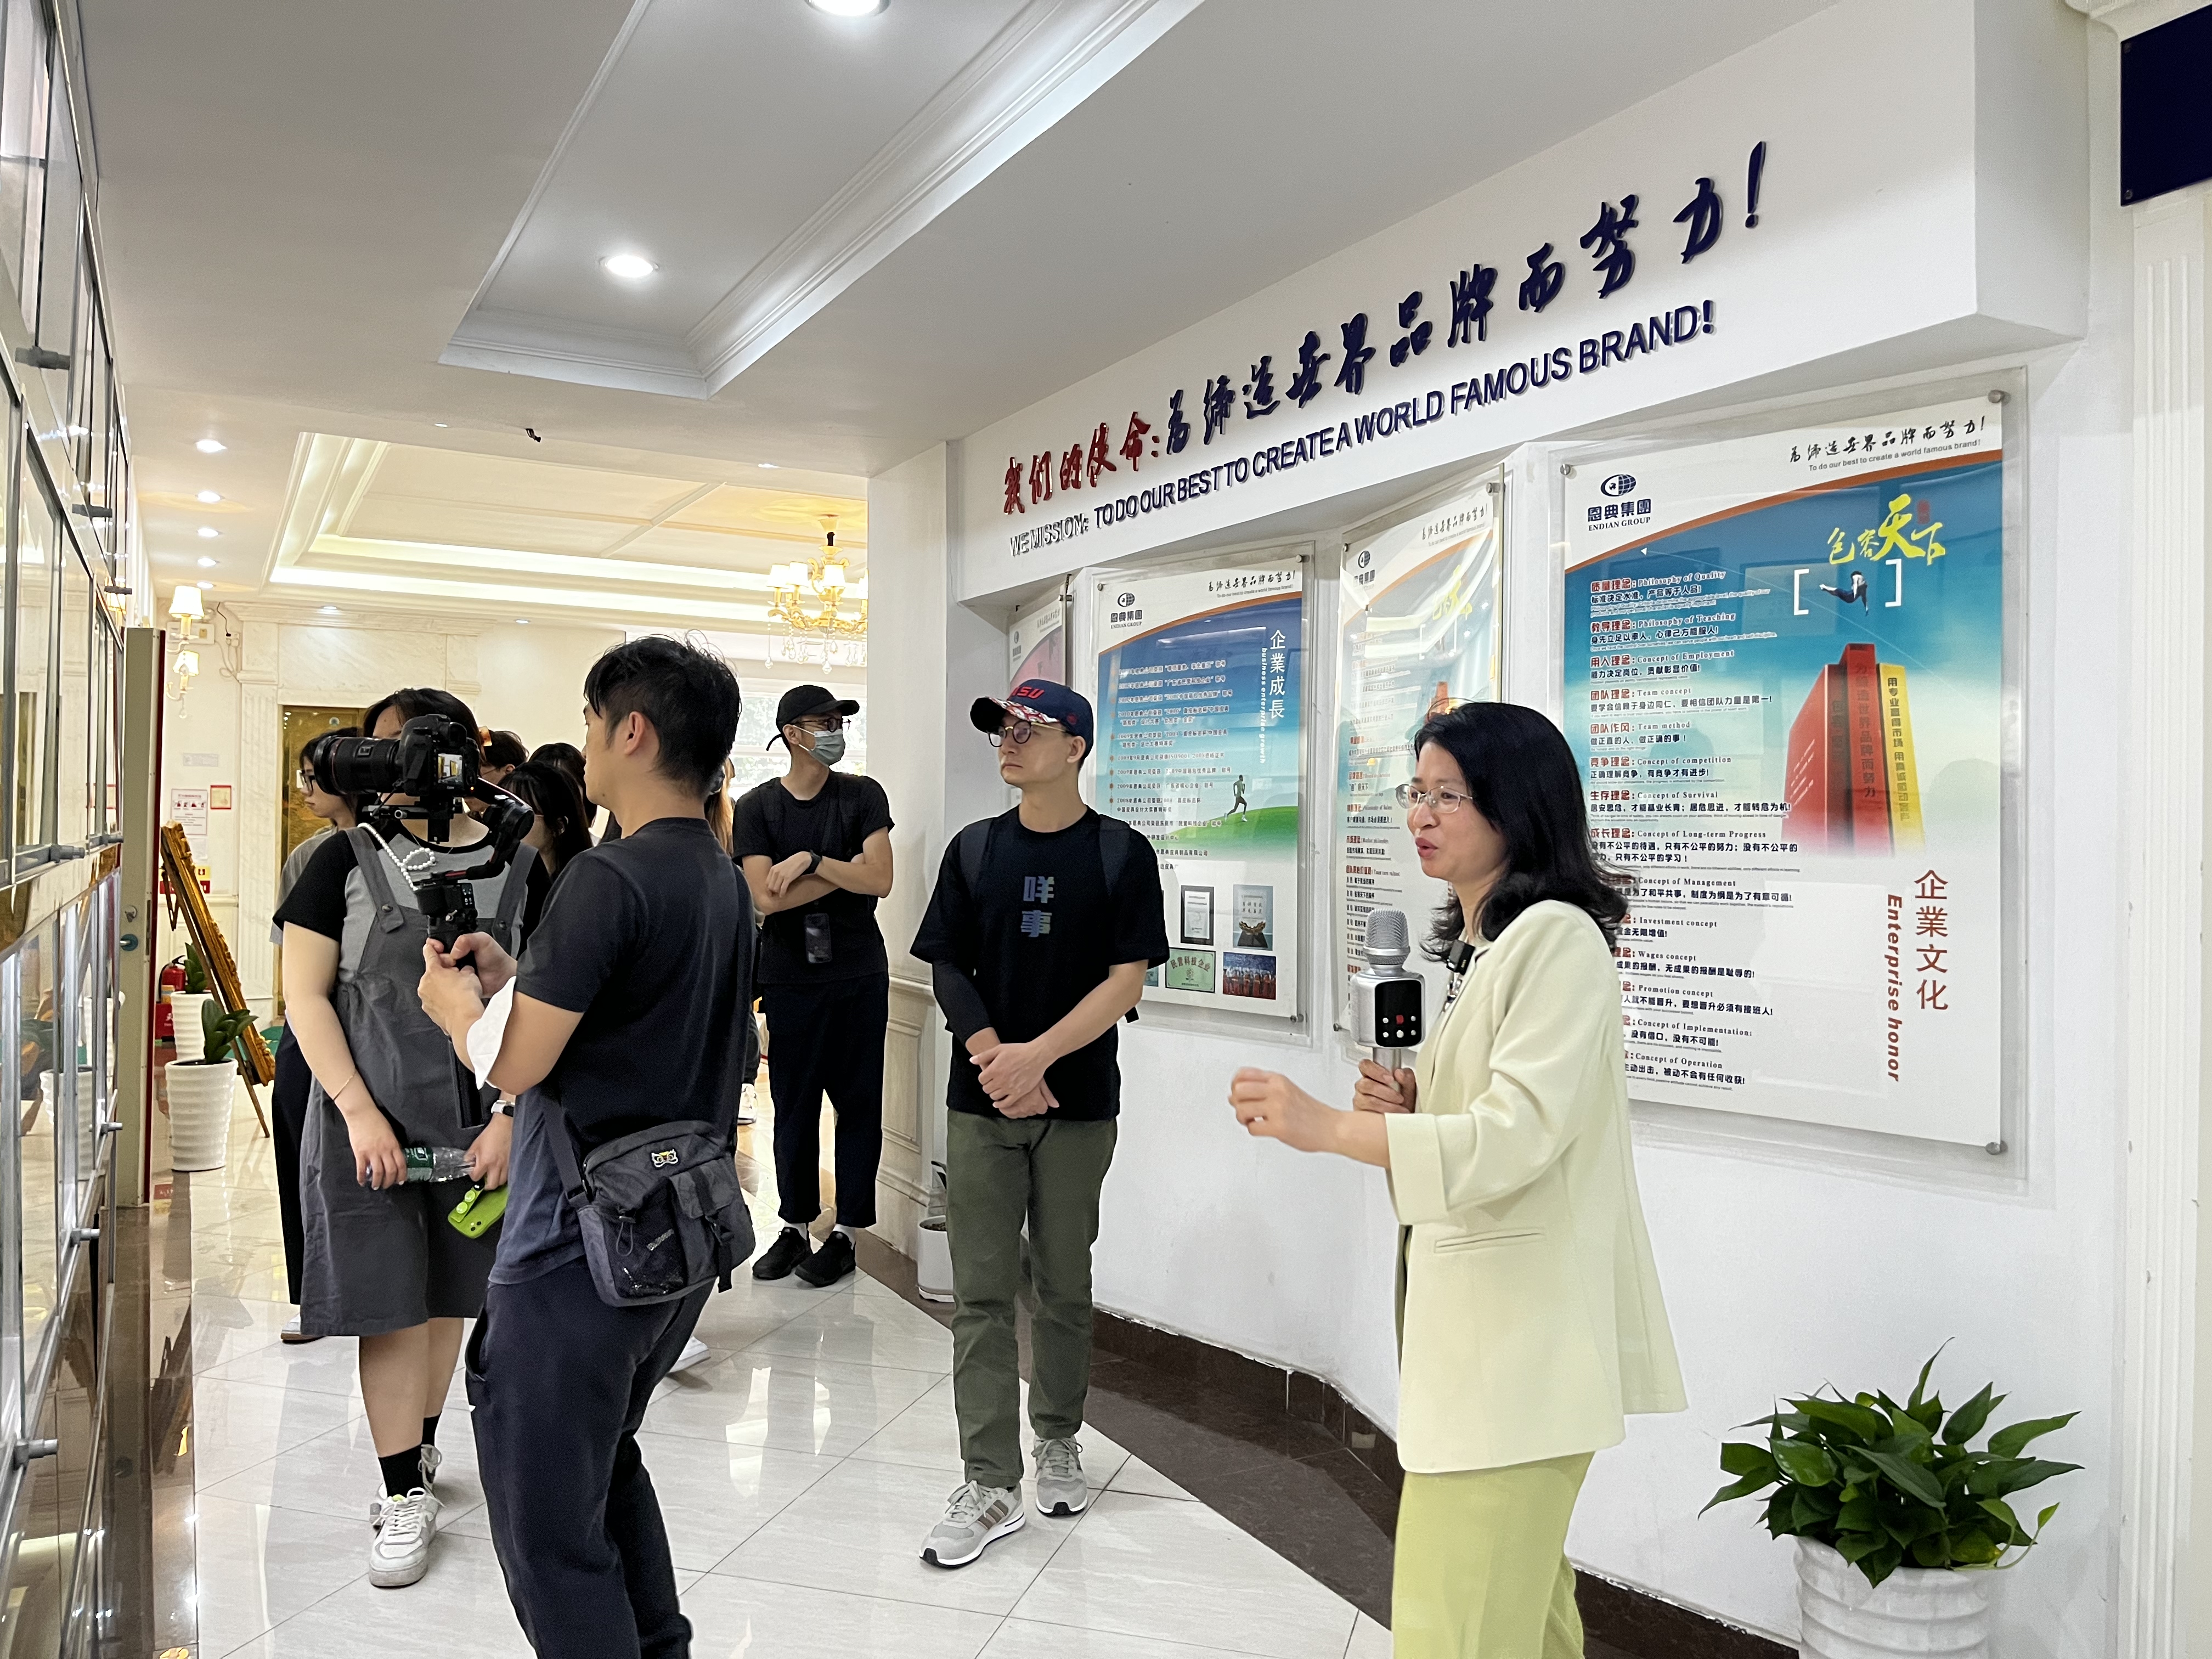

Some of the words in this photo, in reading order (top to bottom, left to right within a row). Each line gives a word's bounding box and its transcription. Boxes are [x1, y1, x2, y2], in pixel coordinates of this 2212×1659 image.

[1009, 533, 1029, 556] WE
[1030, 514, 1089, 549] MISSION:
[1094, 504, 1113, 528] TO
[1116, 495, 1139, 522] DO
[1141, 482, 1176, 514] OUR
[1177, 466, 1223, 502] BEST
[1224, 457, 1249, 487] TO
[1252, 421, 1336, 475] CREATE
[1336, 421, 1355, 451] A
[1355, 391, 1444, 444] WORLD
[1451, 347, 1571, 415] FAMOUS
[1578, 300, 1716, 375] BRAND!
[1869, 453, 1892, 462] create
[1901, 448, 1921, 457] world
[1923, 444, 1953, 454] famous
[1589, 521, 1619, 531] ENDIAN
[1622, 517, 1650, 527] GROUP
[1639, 576, 1681, 586] Philosophy
[1683, 573, 1692, 582] of
[1695, 571, 1725, 581] Quality
[1592, 620, 1635, 633] 教导理念:
[1639, 617, 1682, 628] Philosophy
[1697, 613, 1736, 623] Teaching
[1591, 654, 1635, 667] 用人理念:
[1638, 655, 1668, 663] Concept
[1683, 651, 1735, 661] Employment
[1269, 630, 1286, 719] 企業成長
[1591, 689, 1635, 701] 团队理念:
[1590, 723, 1634, 734] 团队作风:
[1591, 757, 1635, 767] 竞争理念:
[1683, 757, 1731, 765] competition
[1590, 790, 1635, 801] 生存理念:
[1638, 792, 1668, 800] Concept
[1590, 828, 1634, 838] 成长理念:
[1638, 830, 1668, 838] Concept
[1729, 830, 1766, 839] Progress
[1638, 877, 1669, 885] Concept
[1684, 878, 1736, 887] Management
[1640, 917, 1684, 926] Investment
[1914, 870, 1948, 1010] 企業文化
[1638, 951, 1663, 959] Wages
[1884, 894, 1903, 1011] Enterprise
[1638, 985, 1680, 995] Promotion
[1638, 1019, 1669, 1028] Concept
[1888, 1017, 1903, 1082] honor
[1635, 1053, 1667, 1063] Concept
[1681, 1058, 1723, 1069] Operation
